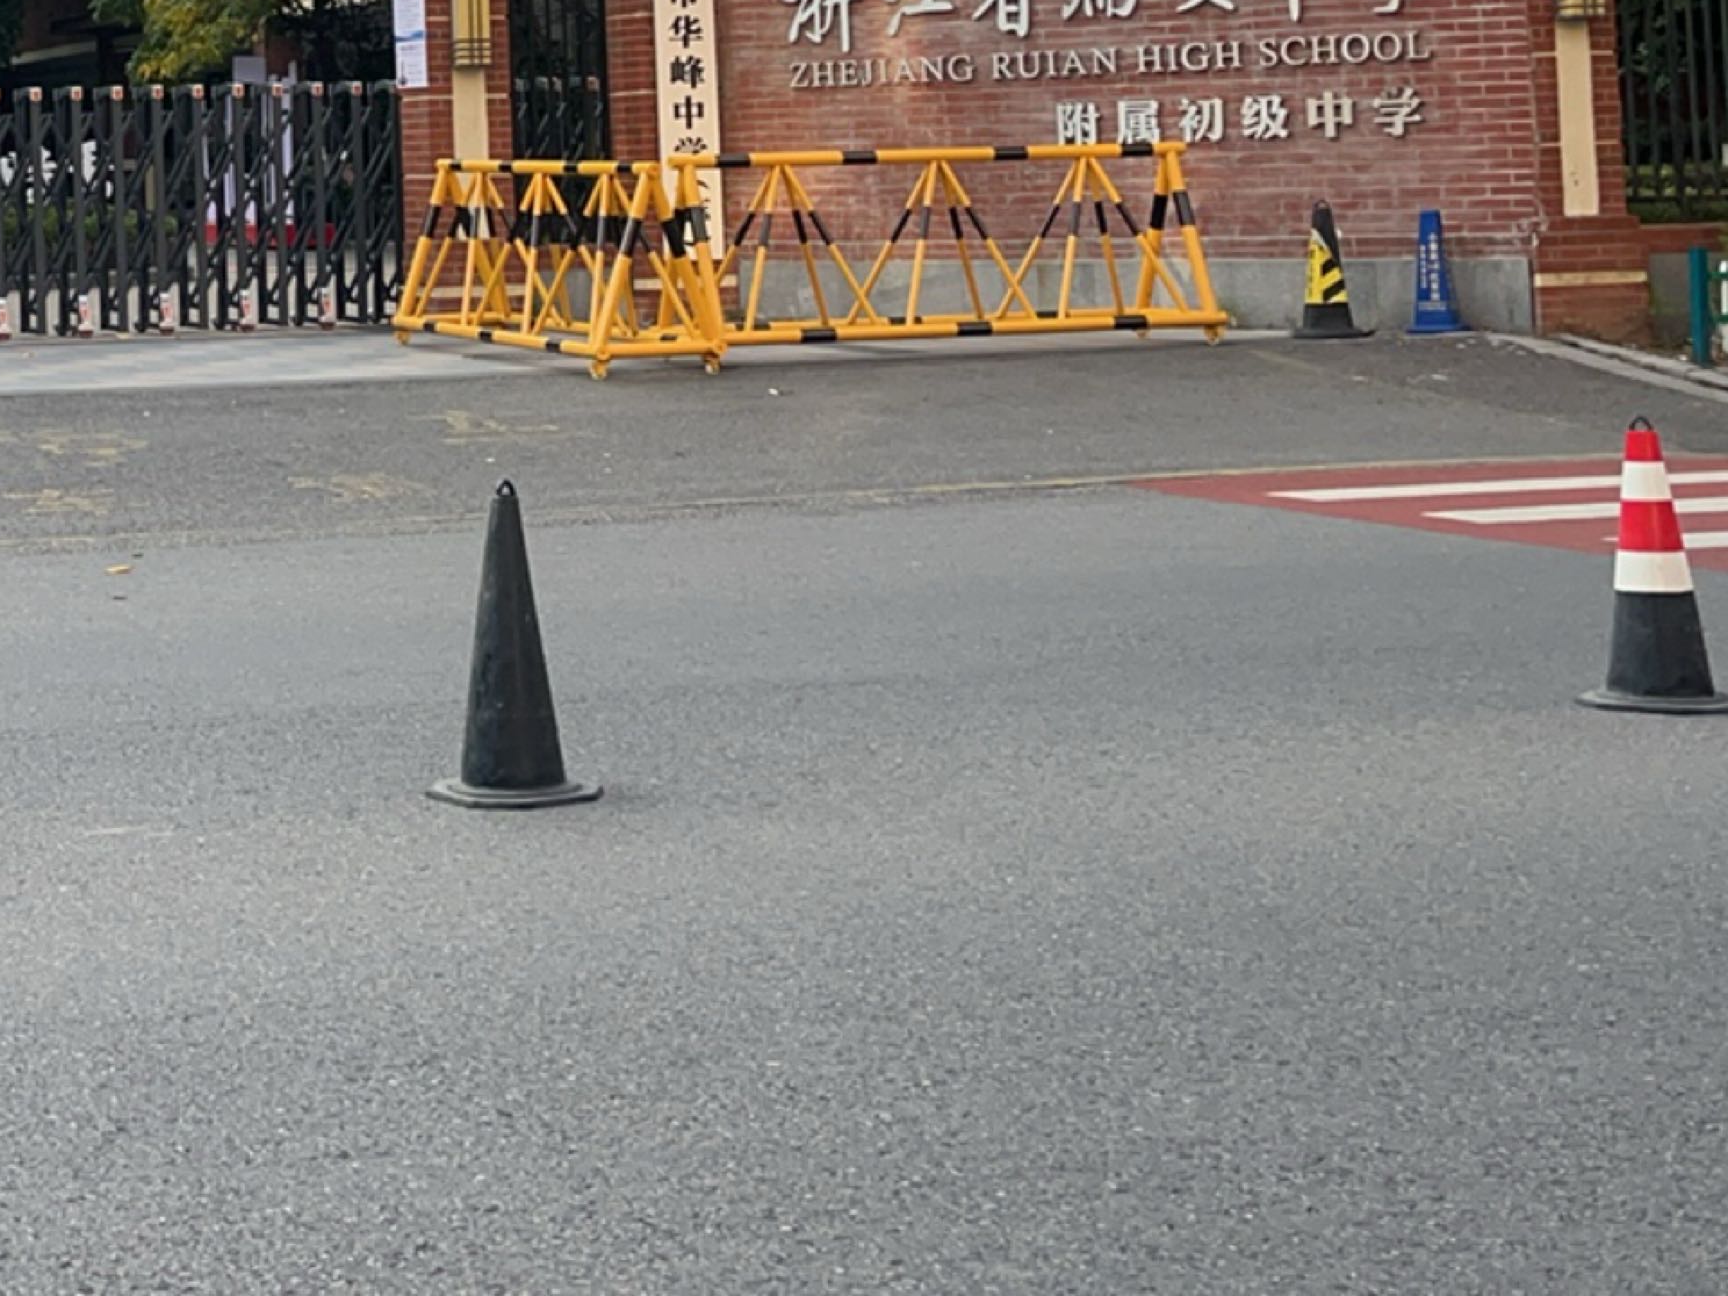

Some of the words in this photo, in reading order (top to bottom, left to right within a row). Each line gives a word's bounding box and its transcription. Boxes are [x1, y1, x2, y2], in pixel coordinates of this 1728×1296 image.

[790, 54, 973, 88] ZHEJIANG
[992, 46, 1116, 80] RUIAN
[1136, 40, 1243, 73] HIGH
[1259, 30, 1430, 66] SCHOOL
[1057, 86, 1422, 145] 附属初级中学
